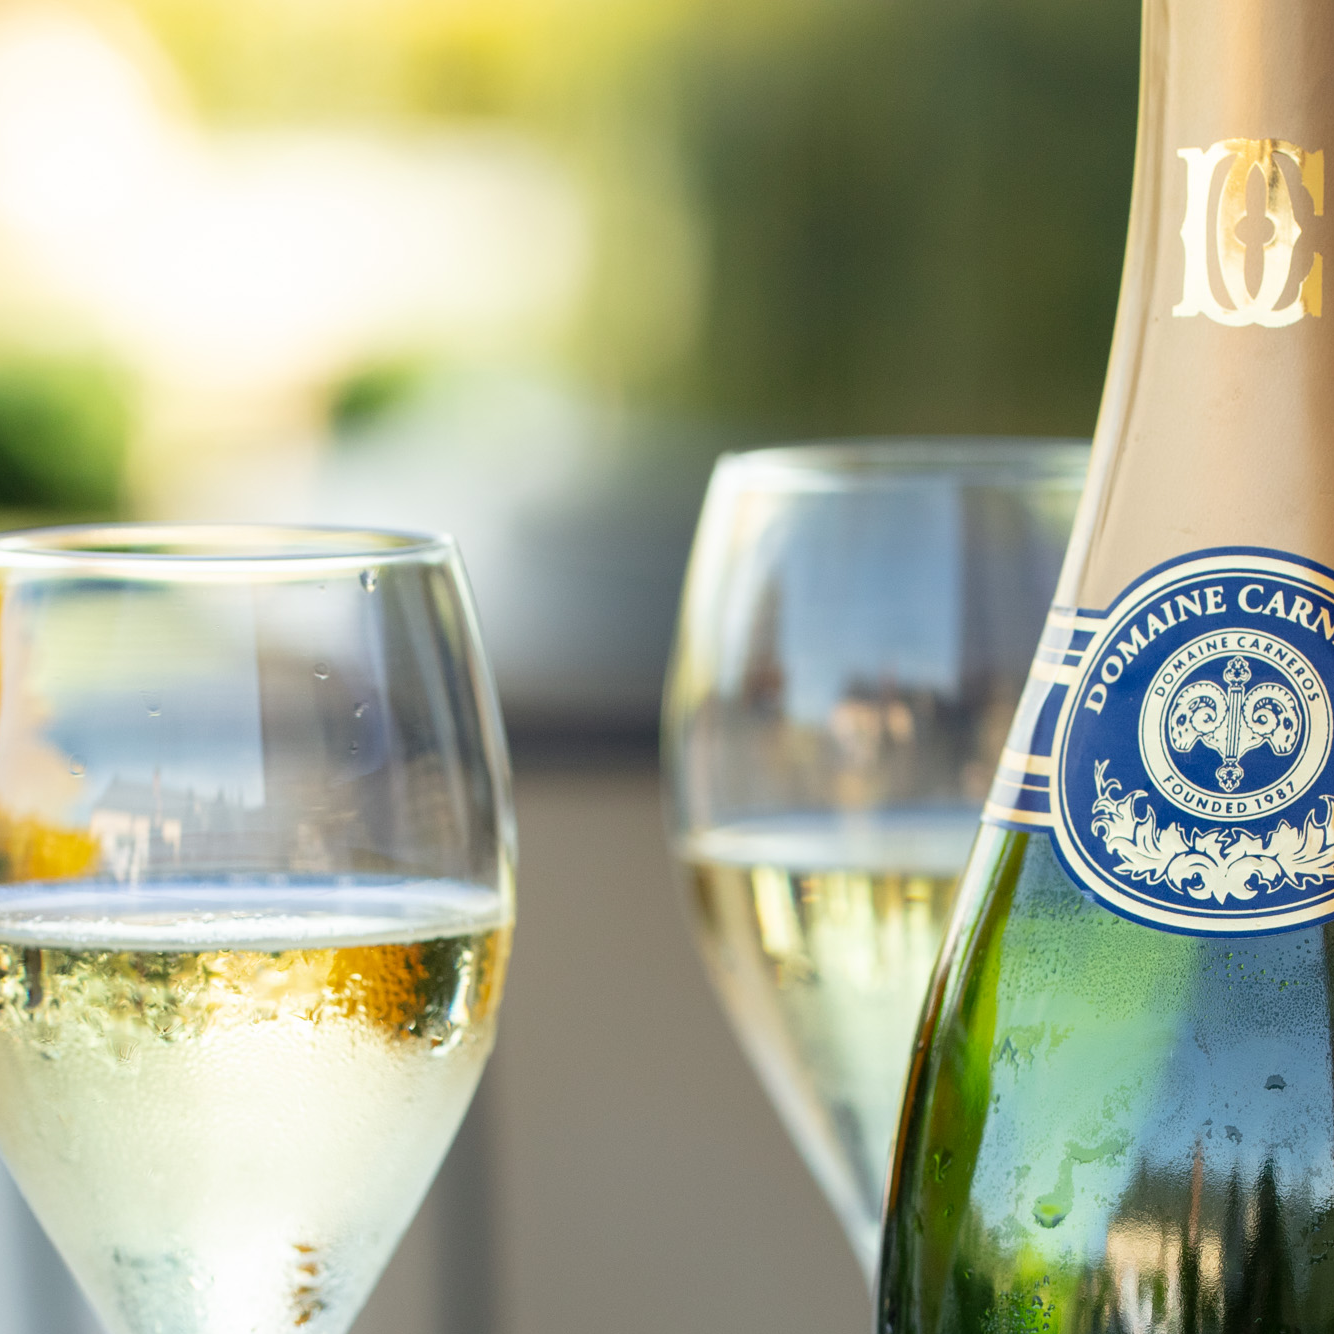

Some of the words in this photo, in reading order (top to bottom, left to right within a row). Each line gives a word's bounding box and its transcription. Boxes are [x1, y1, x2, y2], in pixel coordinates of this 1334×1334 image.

[1083, 585, 1227, 715] DOMAINE
[1154, 637, 1228, 698] DOMAINE
[1237, 636, 1320, 702] CARNEROS
[1163, 775, 1247, 814] FOUNDED
[1254, 780, 1295, 810] 1987
